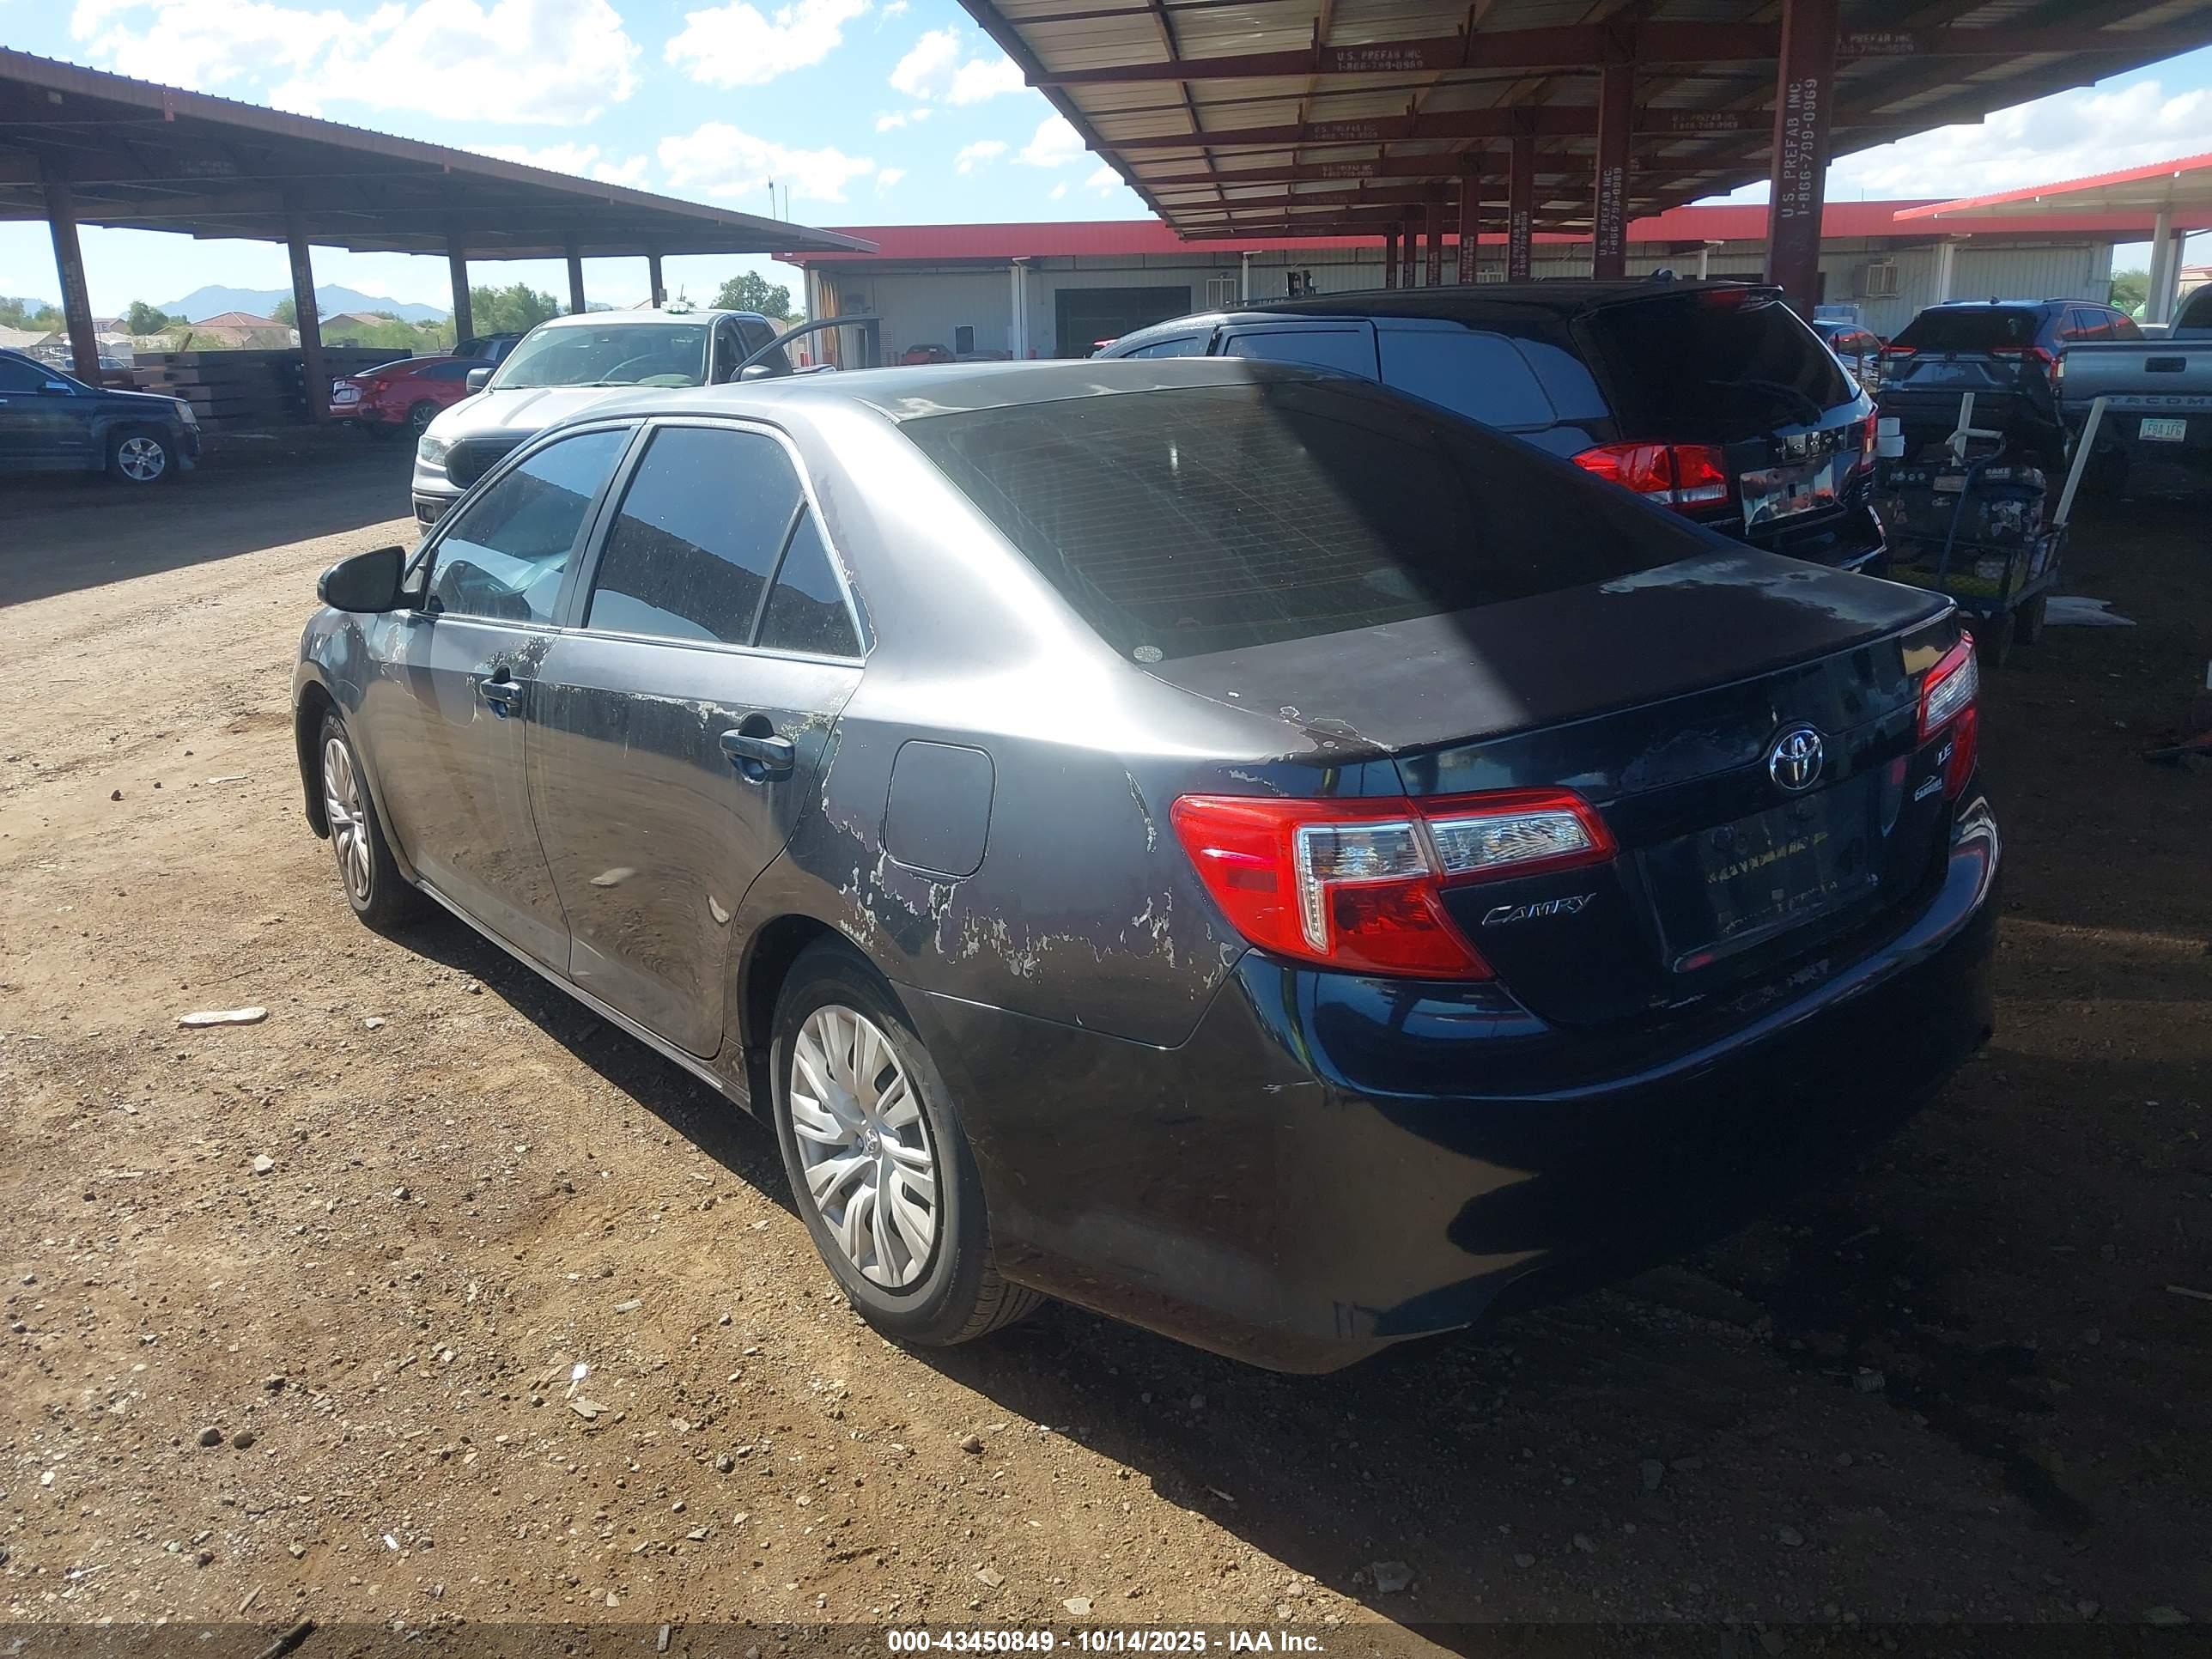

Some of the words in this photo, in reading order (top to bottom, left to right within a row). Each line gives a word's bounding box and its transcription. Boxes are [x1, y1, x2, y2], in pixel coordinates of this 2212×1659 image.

[1783, 117, 1800, 179] PREFAB
[1796, 78, 1818, 216] 1-866-799-0969
[1600, 191, 1612, 232] PREFAB
[1781, 187, 1796, 218] U.S.
[1936, 742, 1952, 767] LE
[1481, 891, 1597, 927] CAMRY
